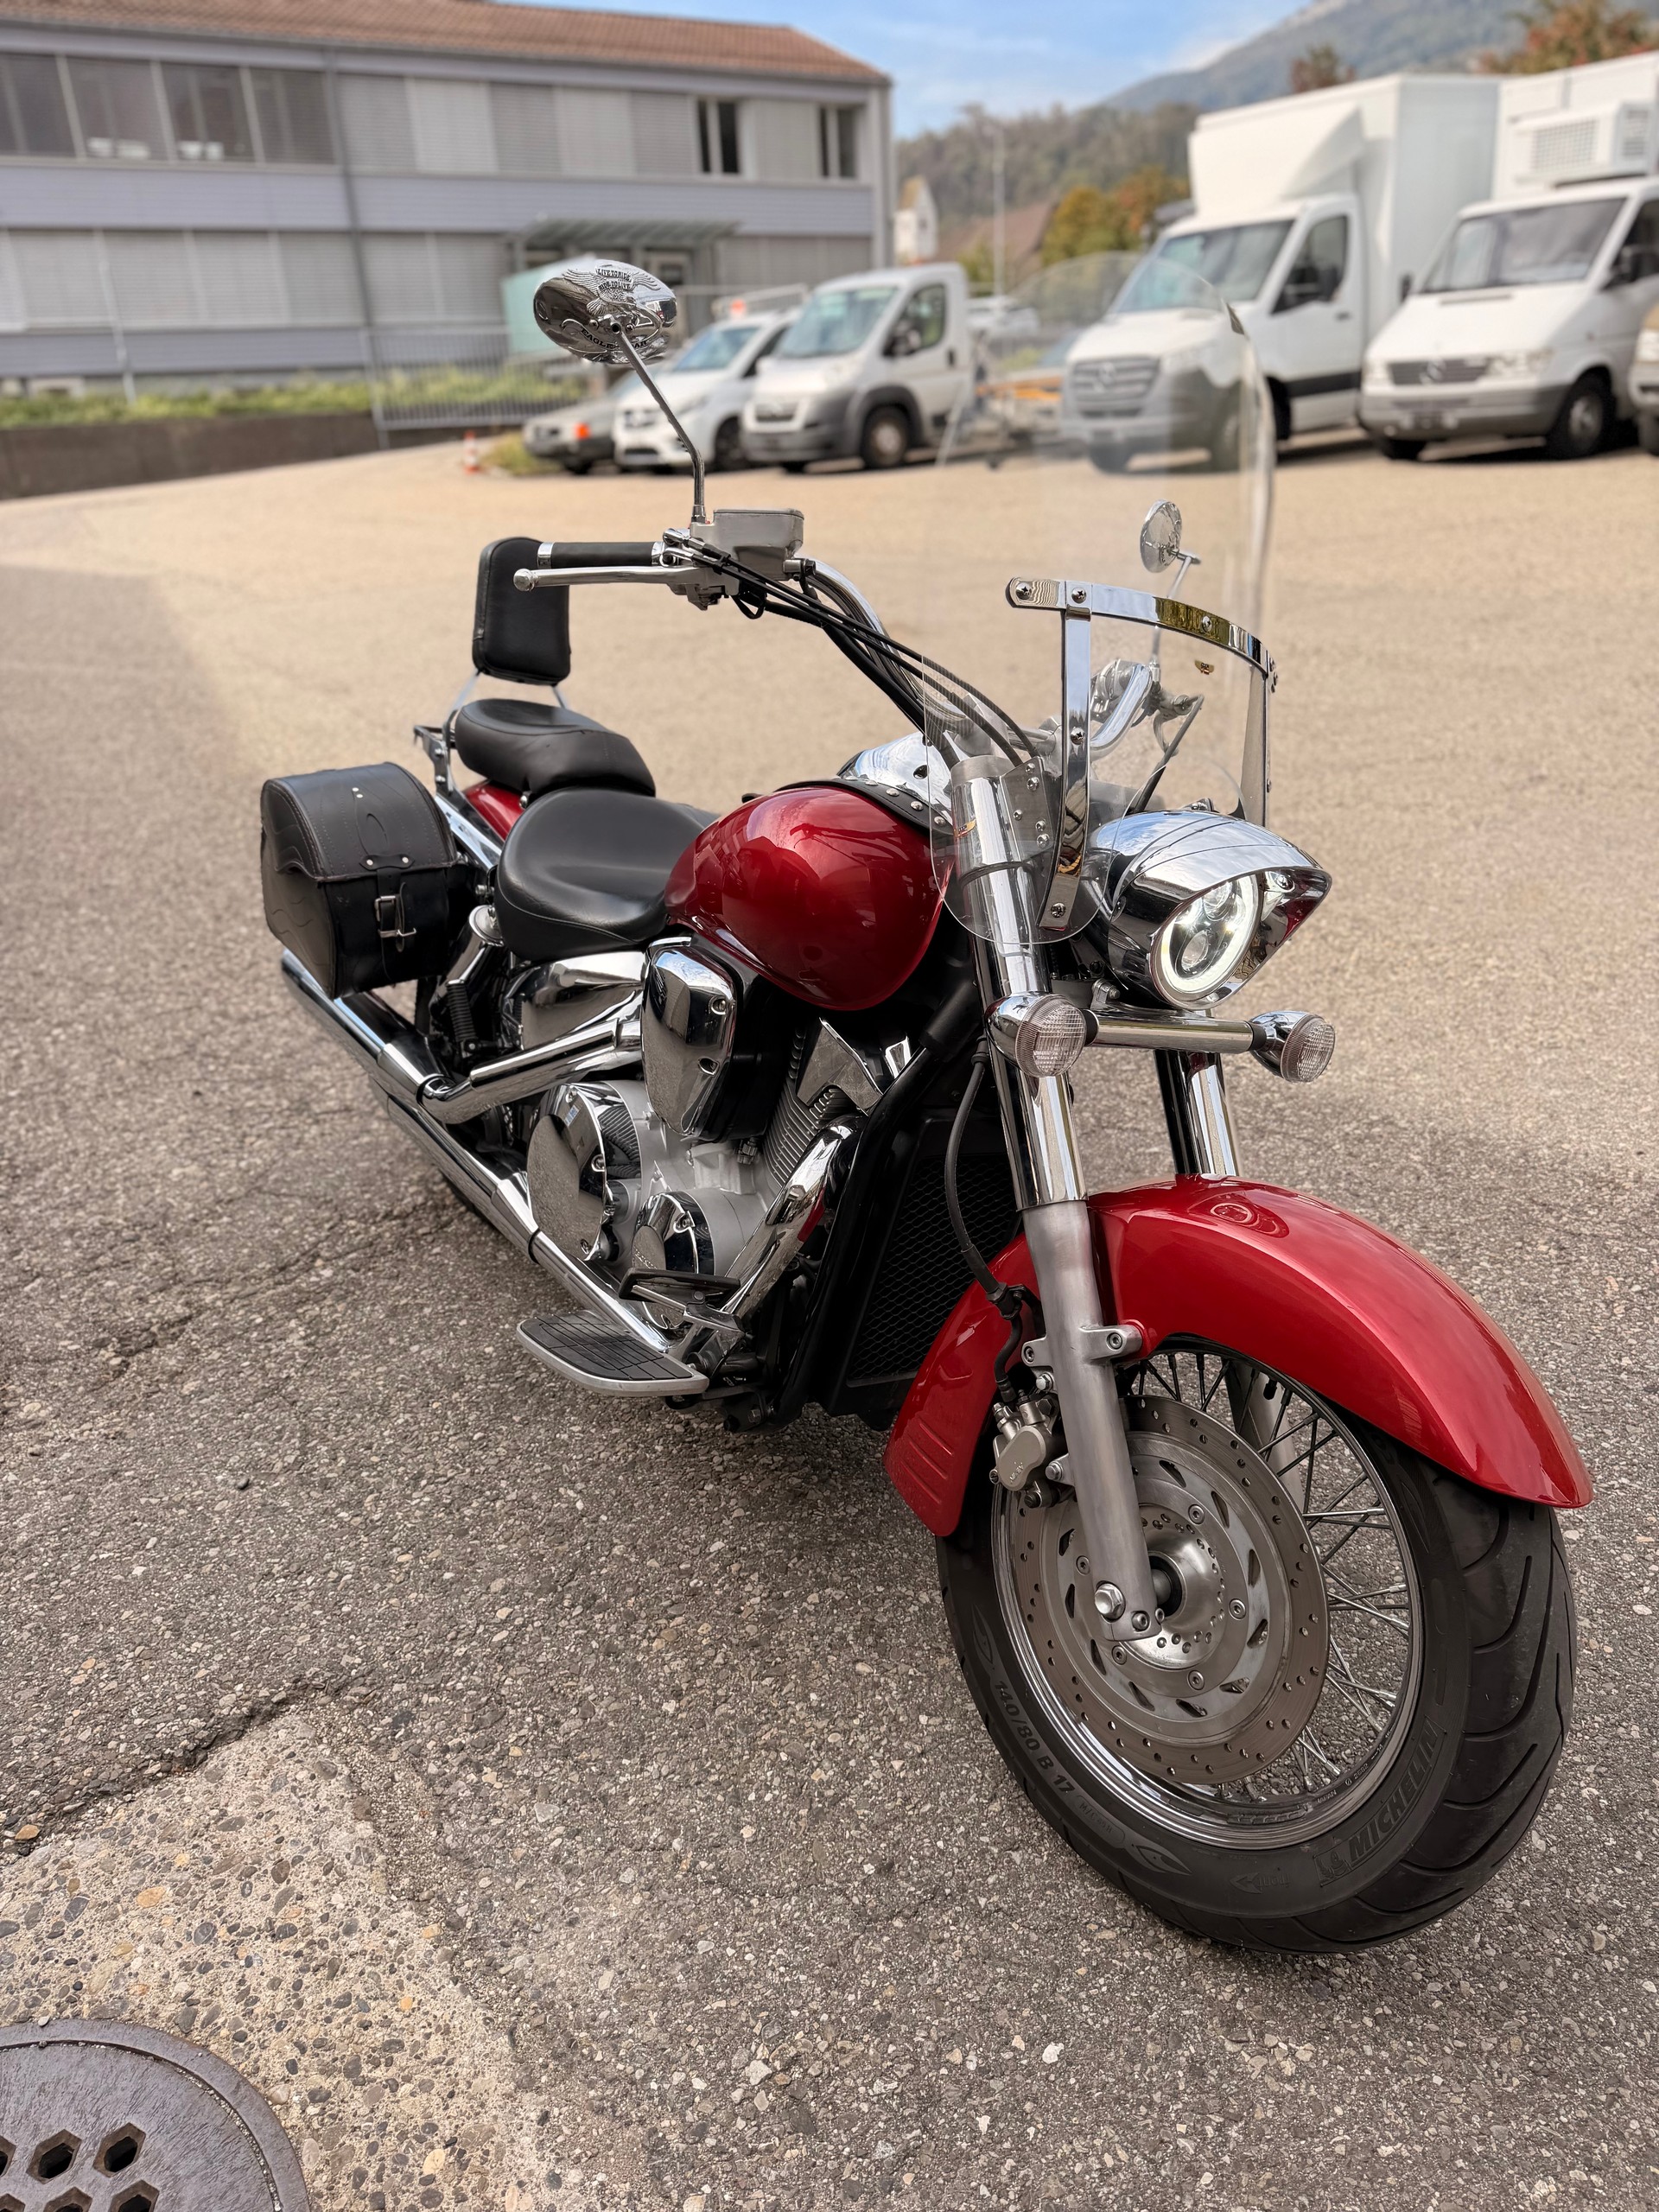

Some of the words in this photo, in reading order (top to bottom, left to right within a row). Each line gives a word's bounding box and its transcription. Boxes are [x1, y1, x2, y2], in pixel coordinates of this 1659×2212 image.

[597, 268, 611, 276] LIVE
[995, 1681, 1041, 1751] 140/80
[1037, 1755, 1055, 1770] B
[1052, 1773, 1077, 1793] 17
[1348, 1718, 1440, 1862] MICHELIN
